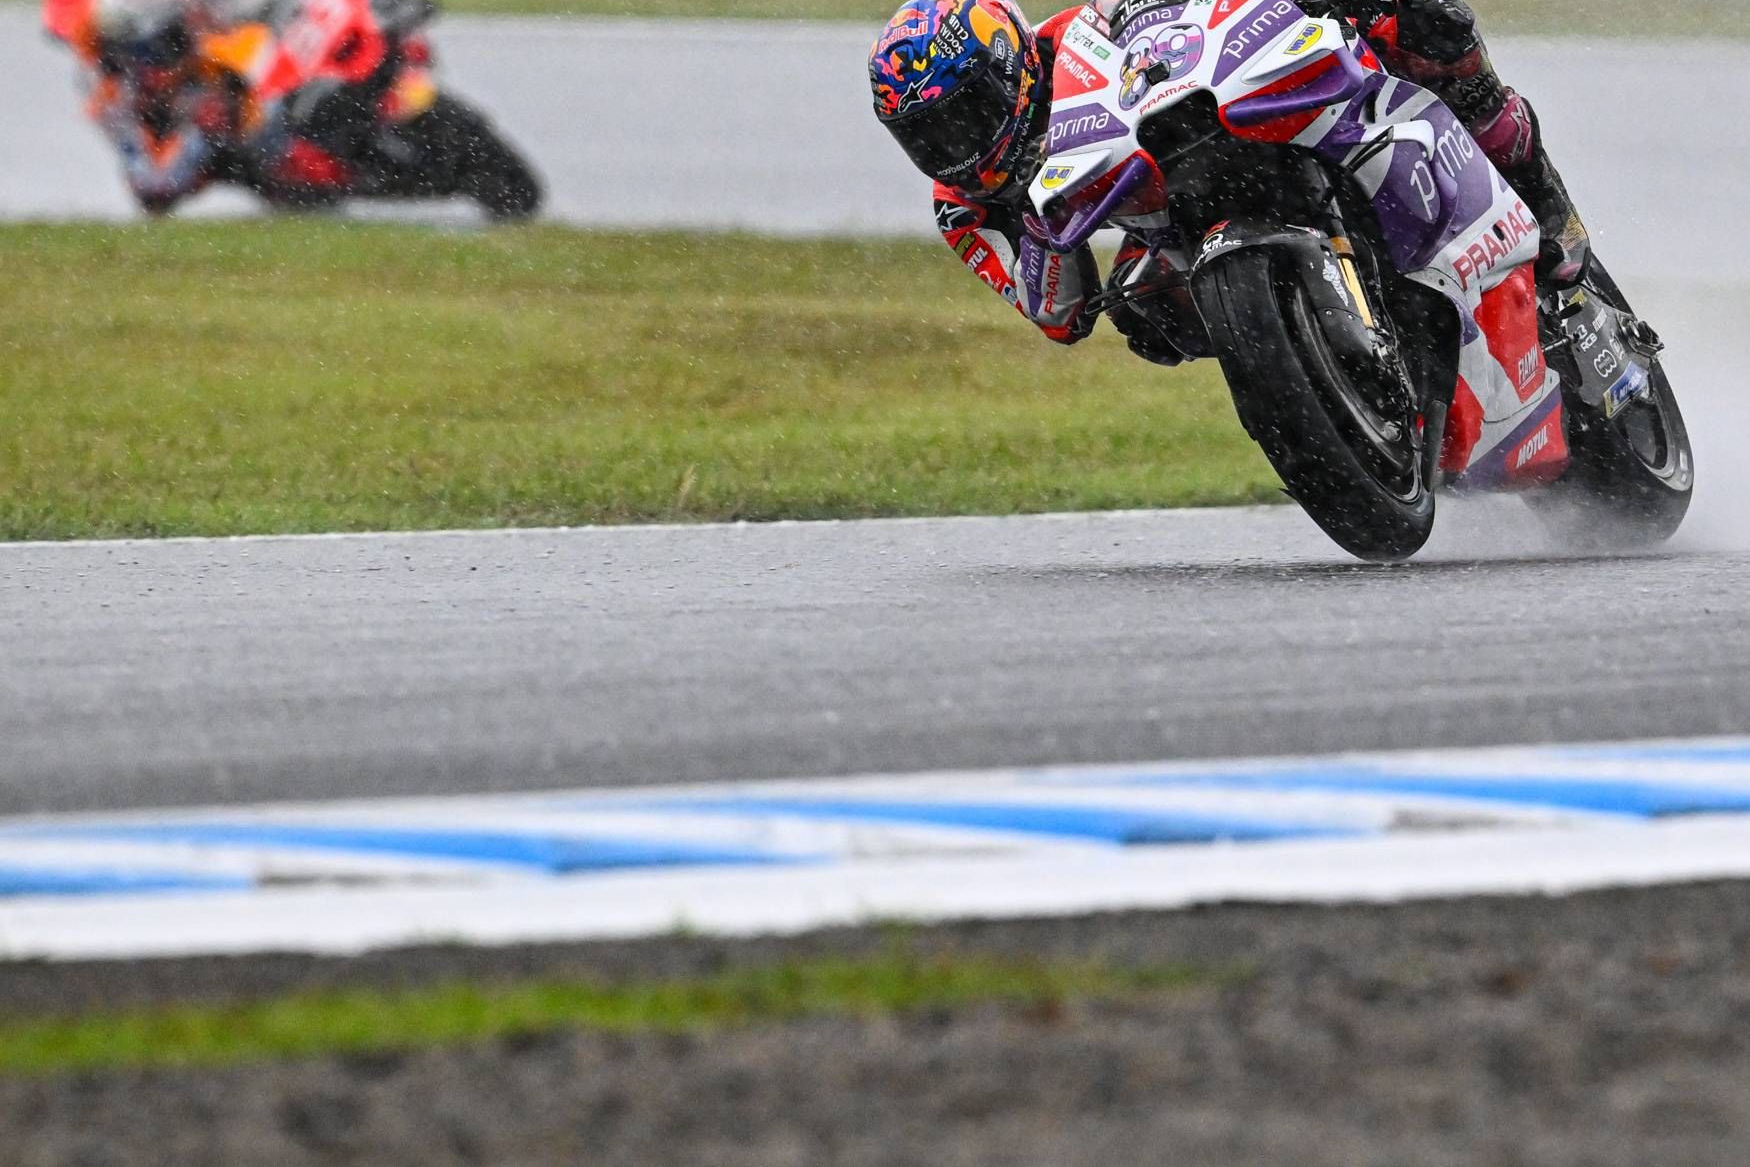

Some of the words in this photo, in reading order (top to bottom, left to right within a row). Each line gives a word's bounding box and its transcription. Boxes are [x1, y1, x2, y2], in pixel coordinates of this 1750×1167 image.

[939, 23, 965, 54] SOCIAL
[949, 14, 969, 41] CLUB
[1123, 7, 1173, 43] prima
[1223, 0, 1292, 58] prima
[1056, 51, 1097, 88] PRAMAC
[1118, 22, 1205, 112] 89
[1139, 80, 1199, 116] PRAMAC
[1048, 112, 1110, 147] prima
[1452, 201, 1537, 291] PRAMAC
[1044, 254, 1062, 315] PRAMA
[1517, 346, 1538, 382] FIAMM
[1515, 425, 1548, 469] MOTUL
